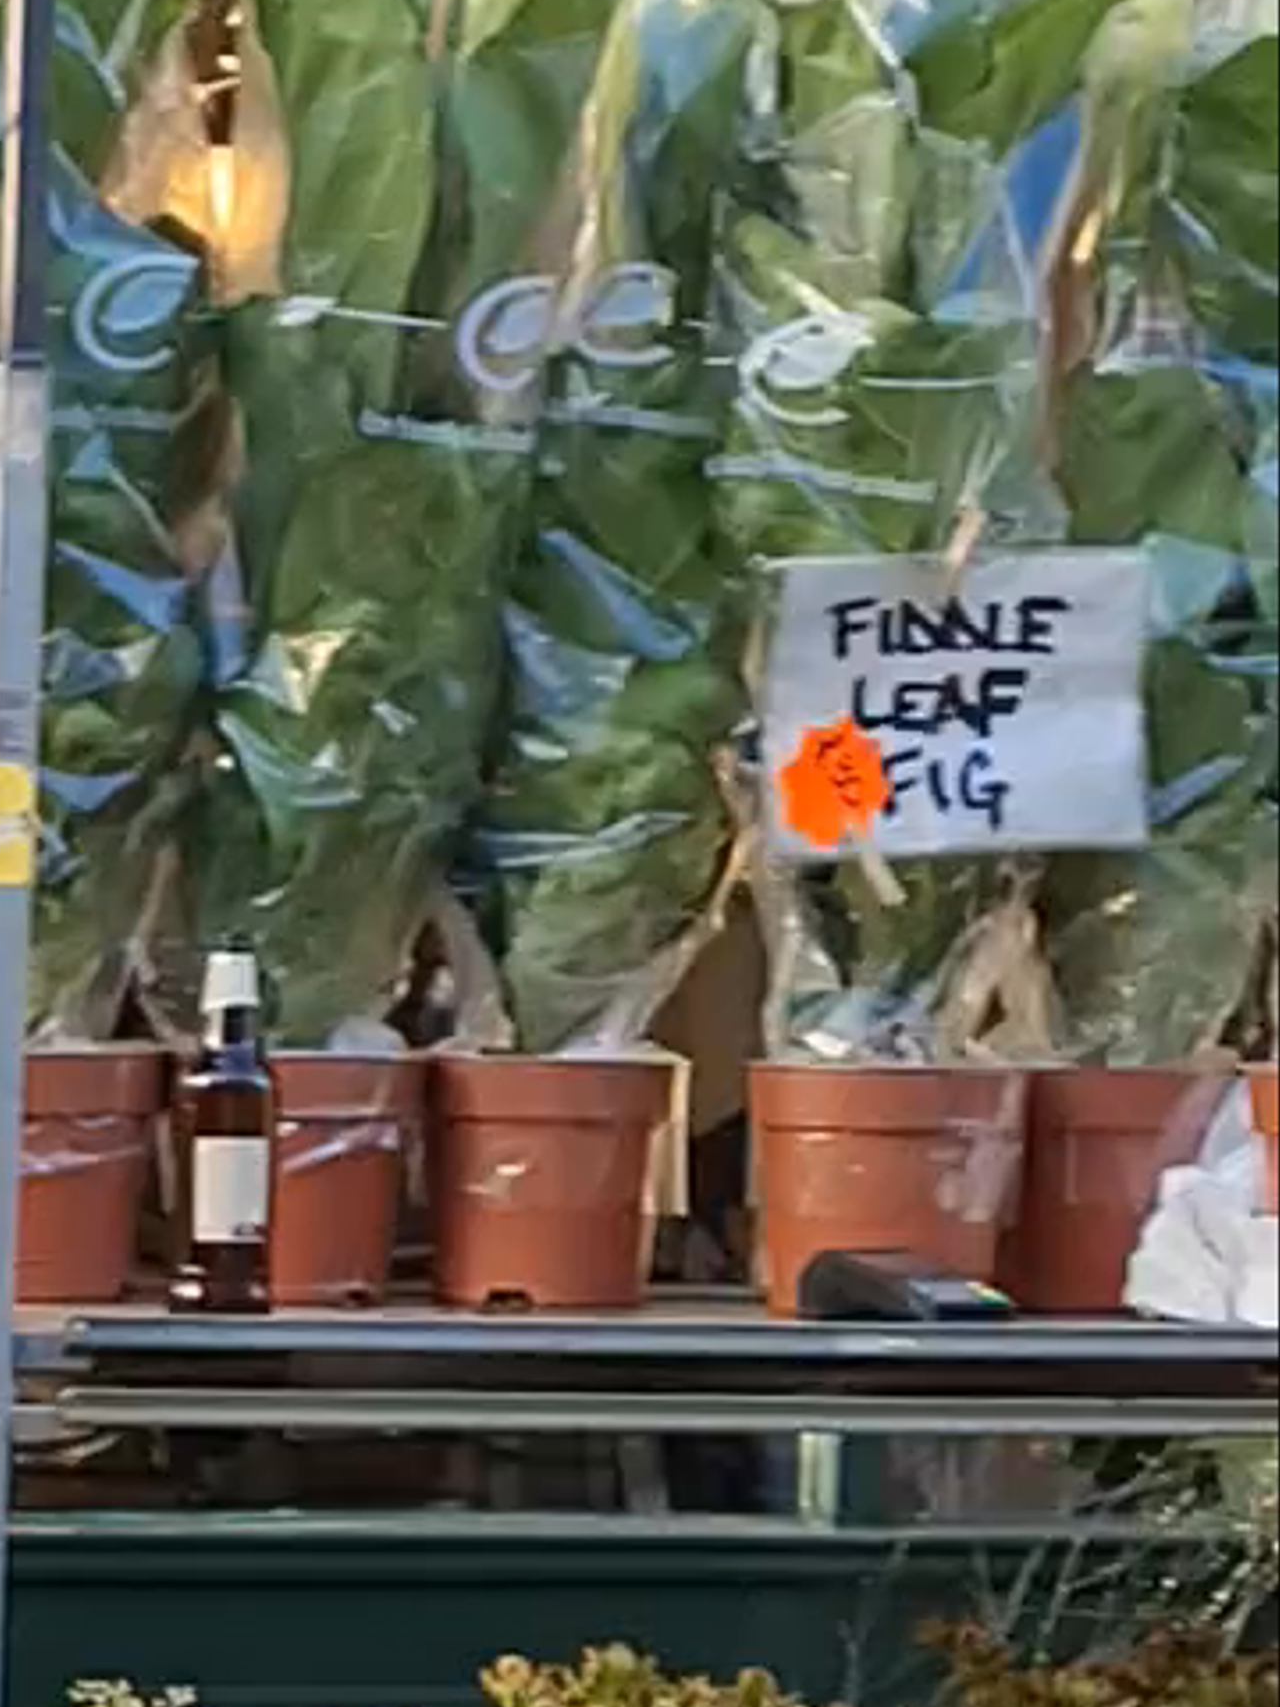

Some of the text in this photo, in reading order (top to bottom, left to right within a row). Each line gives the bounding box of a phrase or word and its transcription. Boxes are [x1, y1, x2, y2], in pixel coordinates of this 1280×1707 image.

[825, 597, 1072, 659] FIDDLE
[853, 667, 1030, 738] LEAF
[881, 746, 1010, 833] FIG
